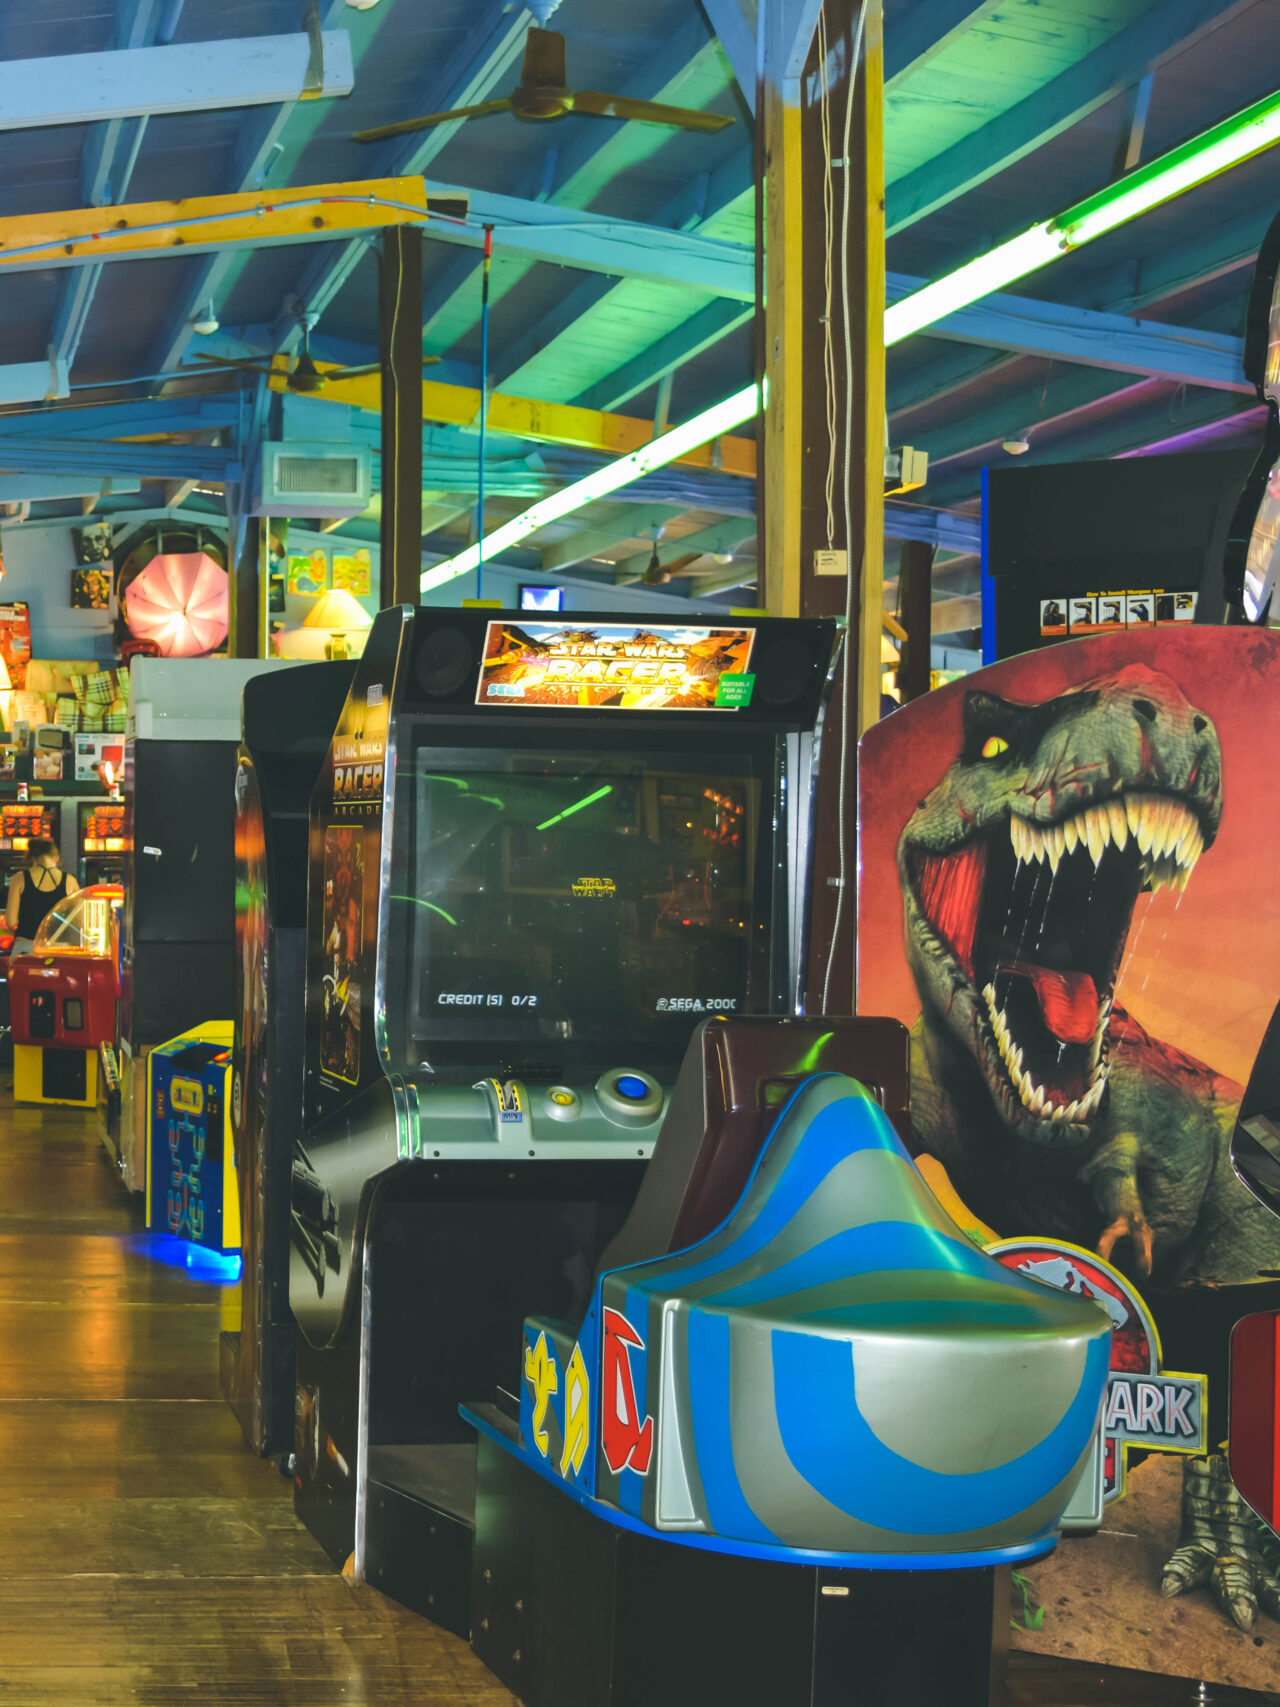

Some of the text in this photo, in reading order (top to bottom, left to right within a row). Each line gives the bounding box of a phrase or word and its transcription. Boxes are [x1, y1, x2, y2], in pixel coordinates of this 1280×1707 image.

[549, 641, 690, 658] STAR WARS
[545, 659, 688, 683] RACER
[487, 684, 525, 696] SEGA
[547, 685, 681, 695] ARCADE
[335, 745, 358, 760] STAR
[333, 764, 383, 797] RACER
[334, 805, 381, 816] ARCADE
[438, 994, 484, 1006] CREDIT
[511, 995, 537, 1007] 0/2
[1106, 1380, 1194, 1435] ARK
